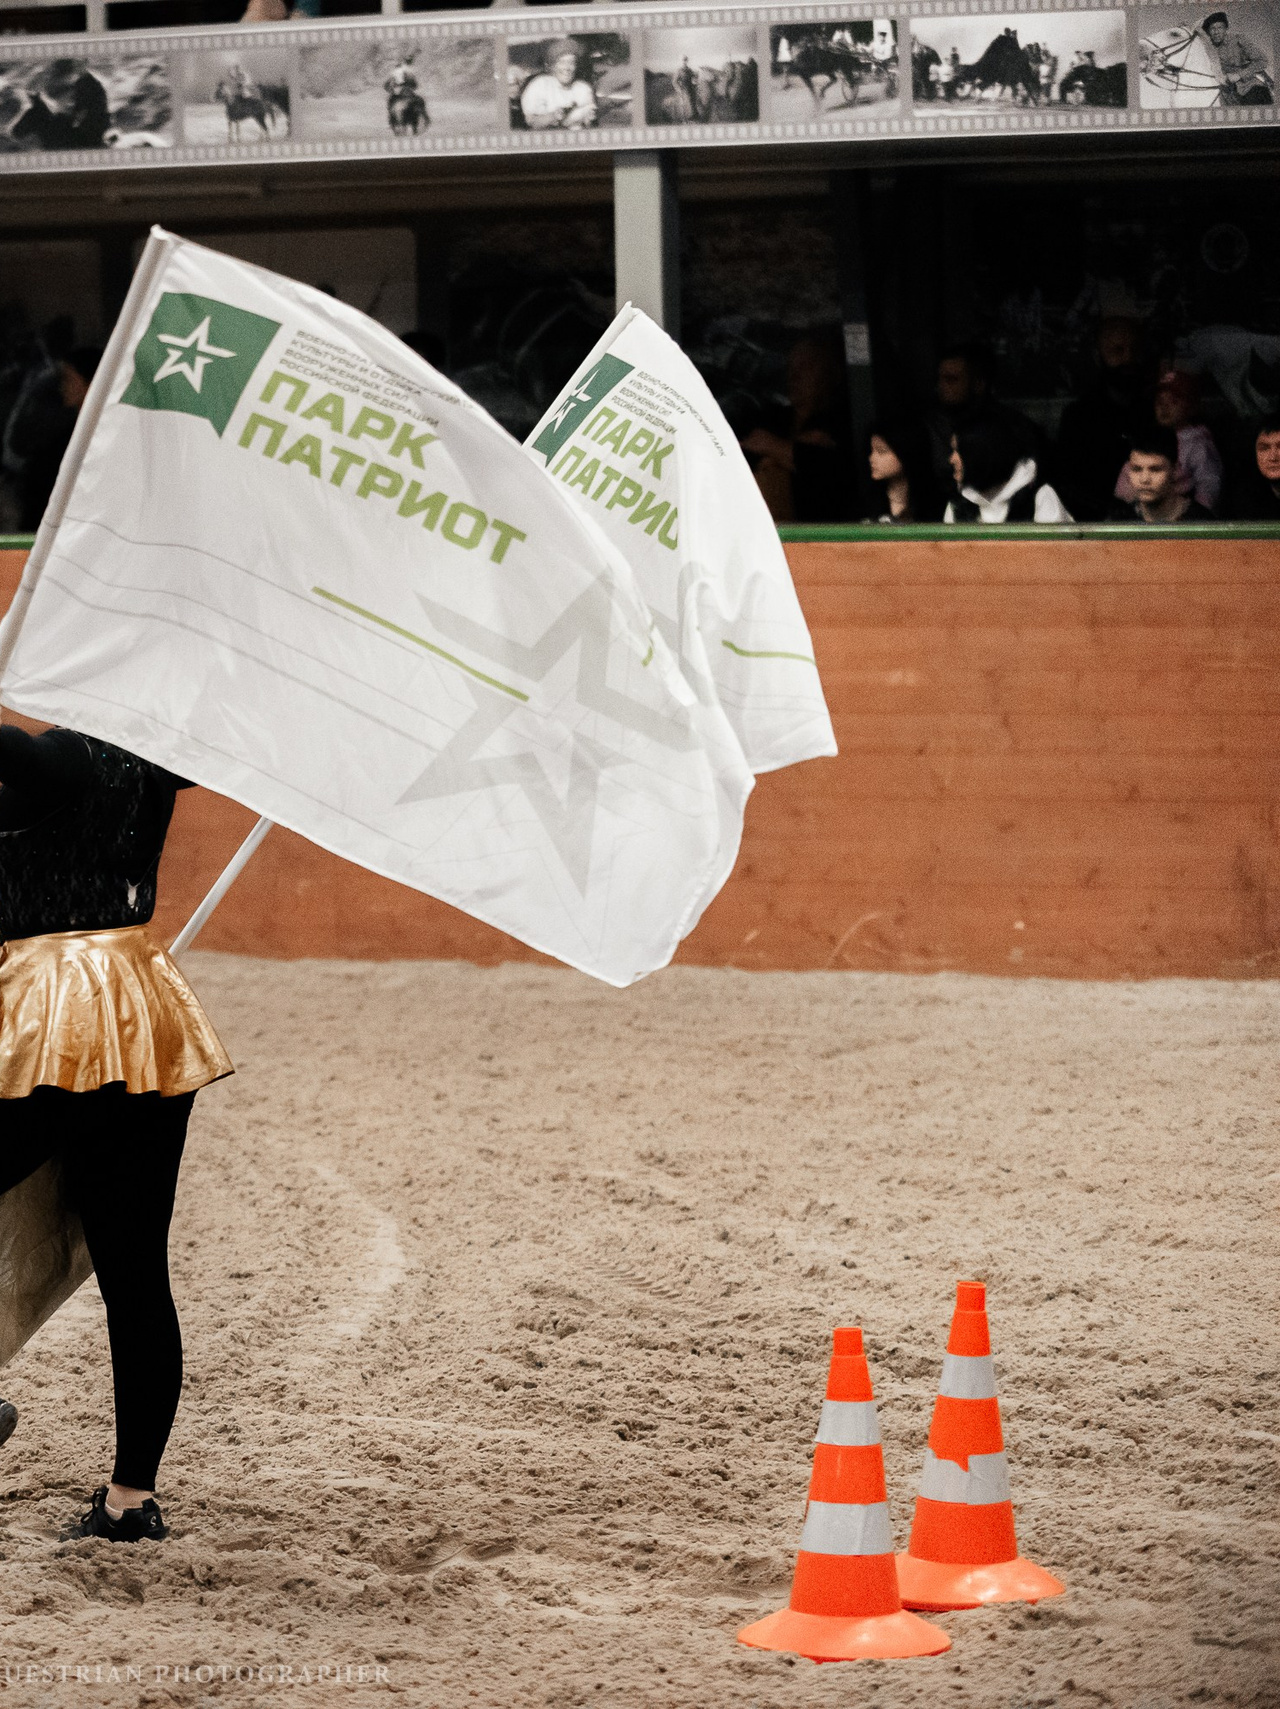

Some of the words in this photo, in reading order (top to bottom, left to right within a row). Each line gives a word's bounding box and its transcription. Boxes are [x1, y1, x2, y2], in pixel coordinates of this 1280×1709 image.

[279, 357, 360, 394] РОССИЙСКОЙ
[285, 349, 380, 392] ВООРУЖЕННЫХ
[383, 386, 409, 401] СИЛ
[290, 339, 357, 369] КУЛЬТУРЫ
[359, 366, 369, 374] И
[258, 370, 441, 470] ПАРК
[582, 406, 675, 481] ПАРК
[238, 412, 527, 565] ПАТРИОТ
